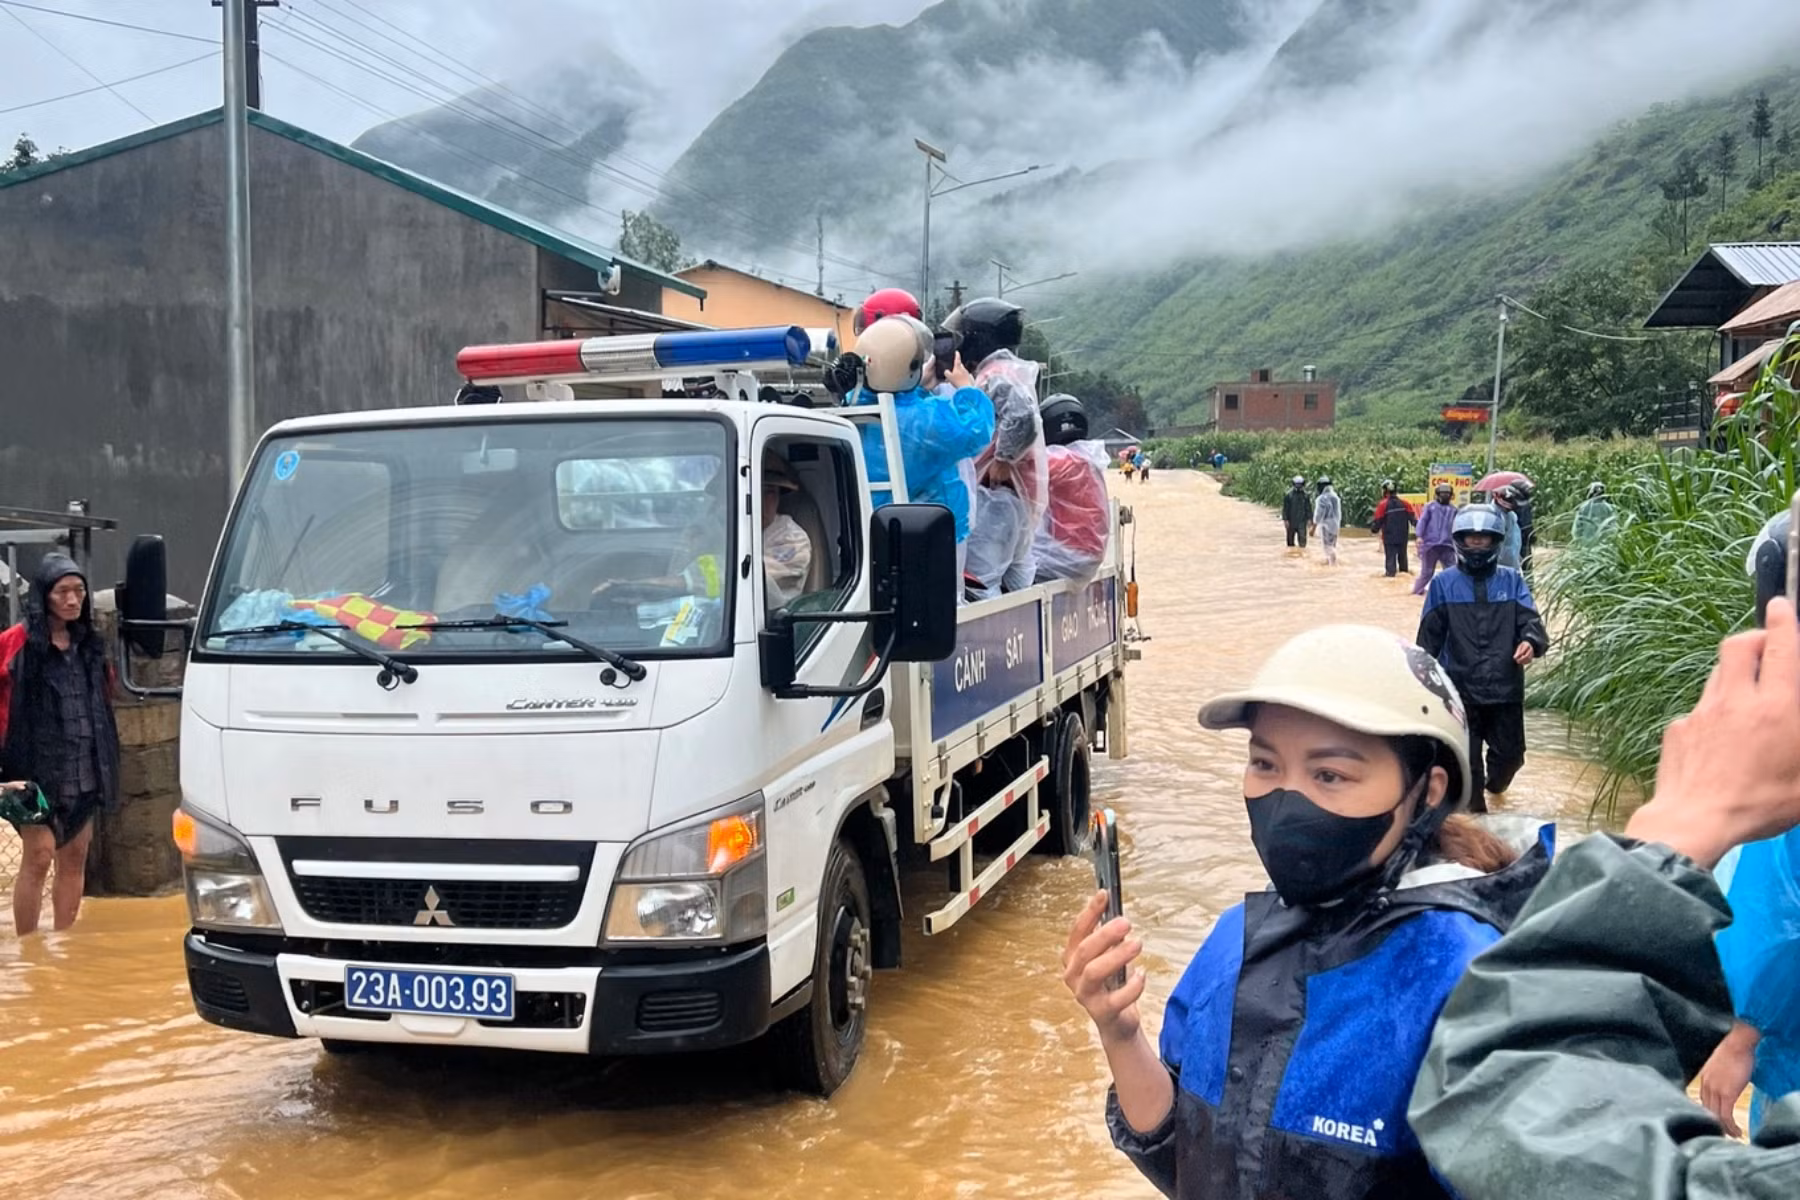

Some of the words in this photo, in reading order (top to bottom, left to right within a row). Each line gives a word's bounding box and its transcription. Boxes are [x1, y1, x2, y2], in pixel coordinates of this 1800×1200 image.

[954, 646, 987, 693] CẢNH
[1006, 627, 1024, 670] SÁT
[290, 797, 573, 815] FUSO
[1312, 1115, 1378, 1147] KOREA
